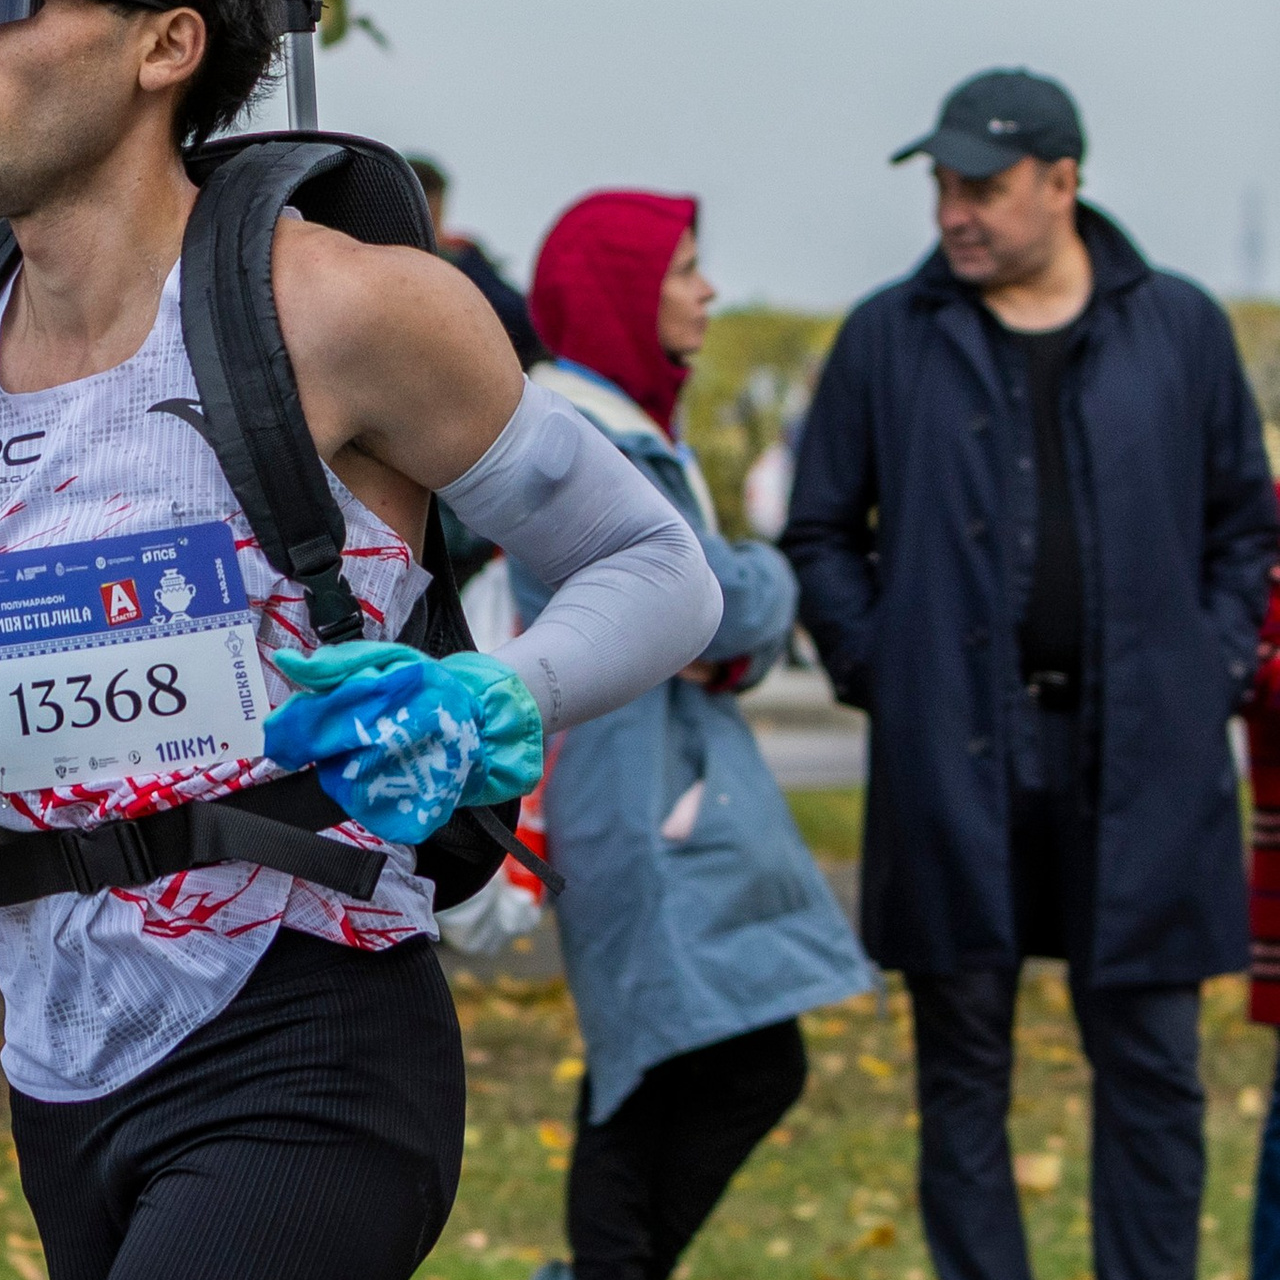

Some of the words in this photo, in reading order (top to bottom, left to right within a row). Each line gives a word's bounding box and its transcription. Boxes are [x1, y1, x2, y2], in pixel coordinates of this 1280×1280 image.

[153, 548, 177, 561] ПСБ
[0, 594, 66, 611] ПОЛУМАРАФОН
[23, 606, 92, 630] СТОЛИЦА
[10, 663, 188, 736] 13368
[233, 660, 257, 721] МОСКВА
